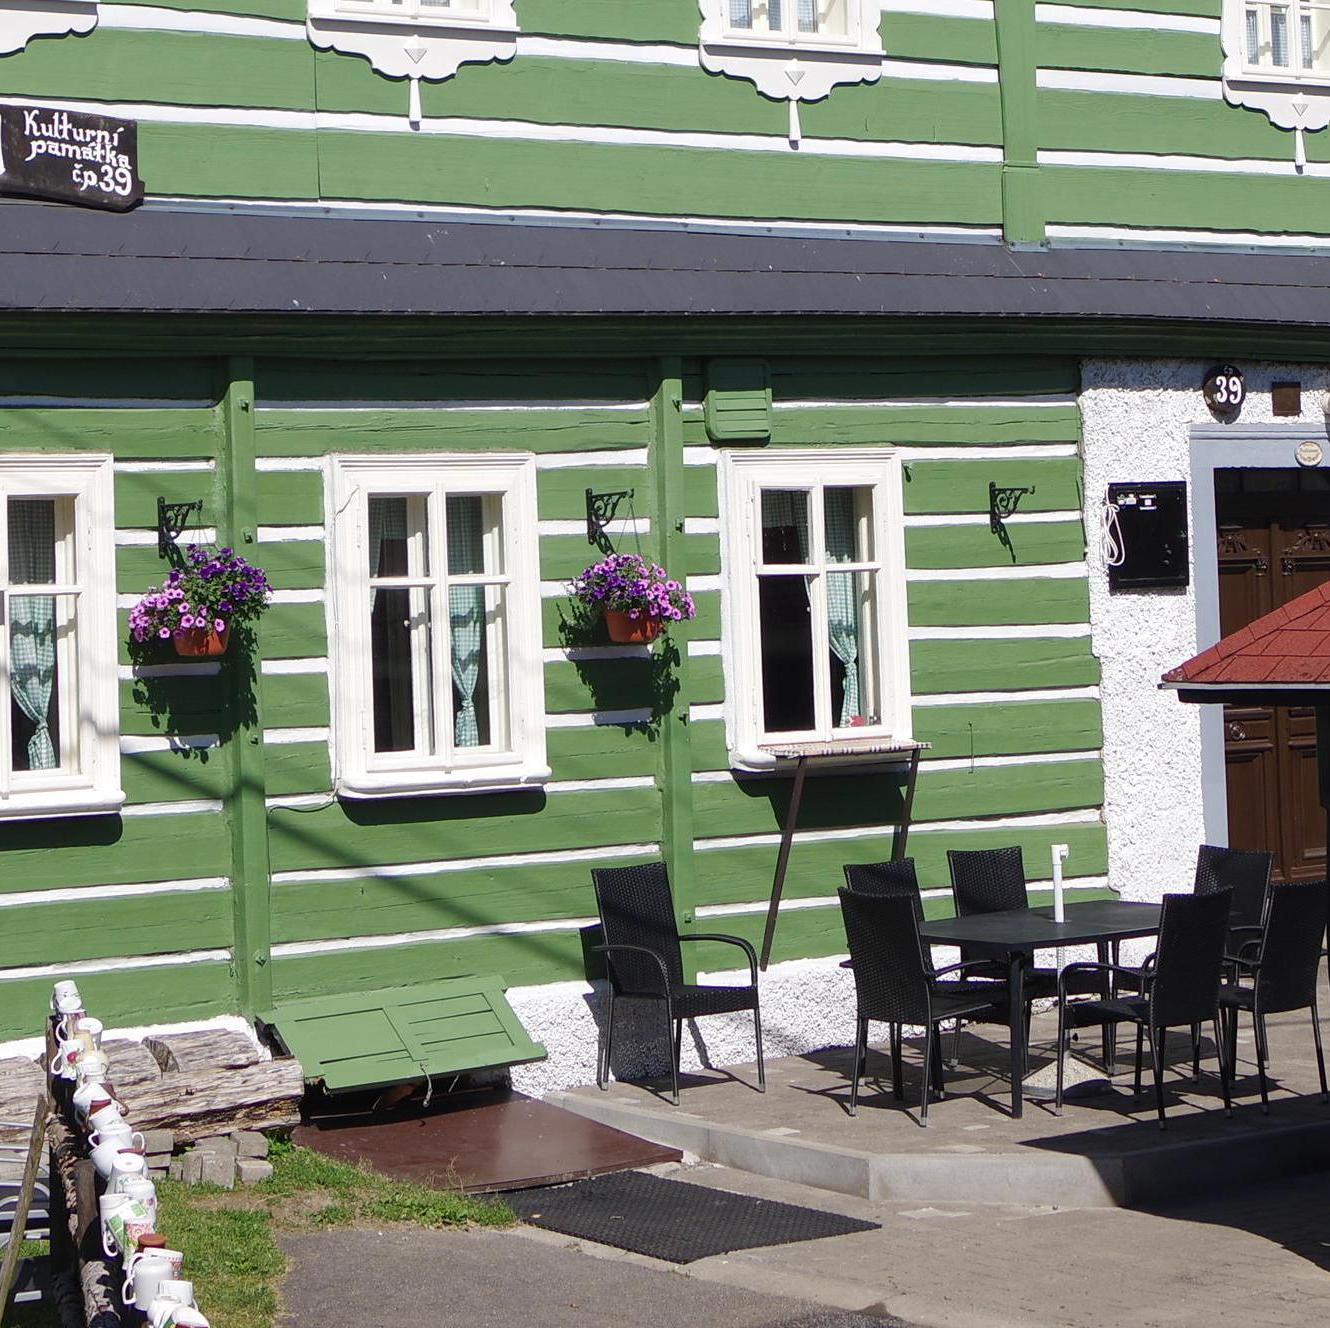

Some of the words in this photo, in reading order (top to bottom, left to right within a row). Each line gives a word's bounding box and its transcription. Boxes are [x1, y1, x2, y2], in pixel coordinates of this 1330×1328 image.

[23, 110, 125, 147] Kulturní
[25, 140, 132, 170] památka
[1216, 375, 1242, 404] 39
